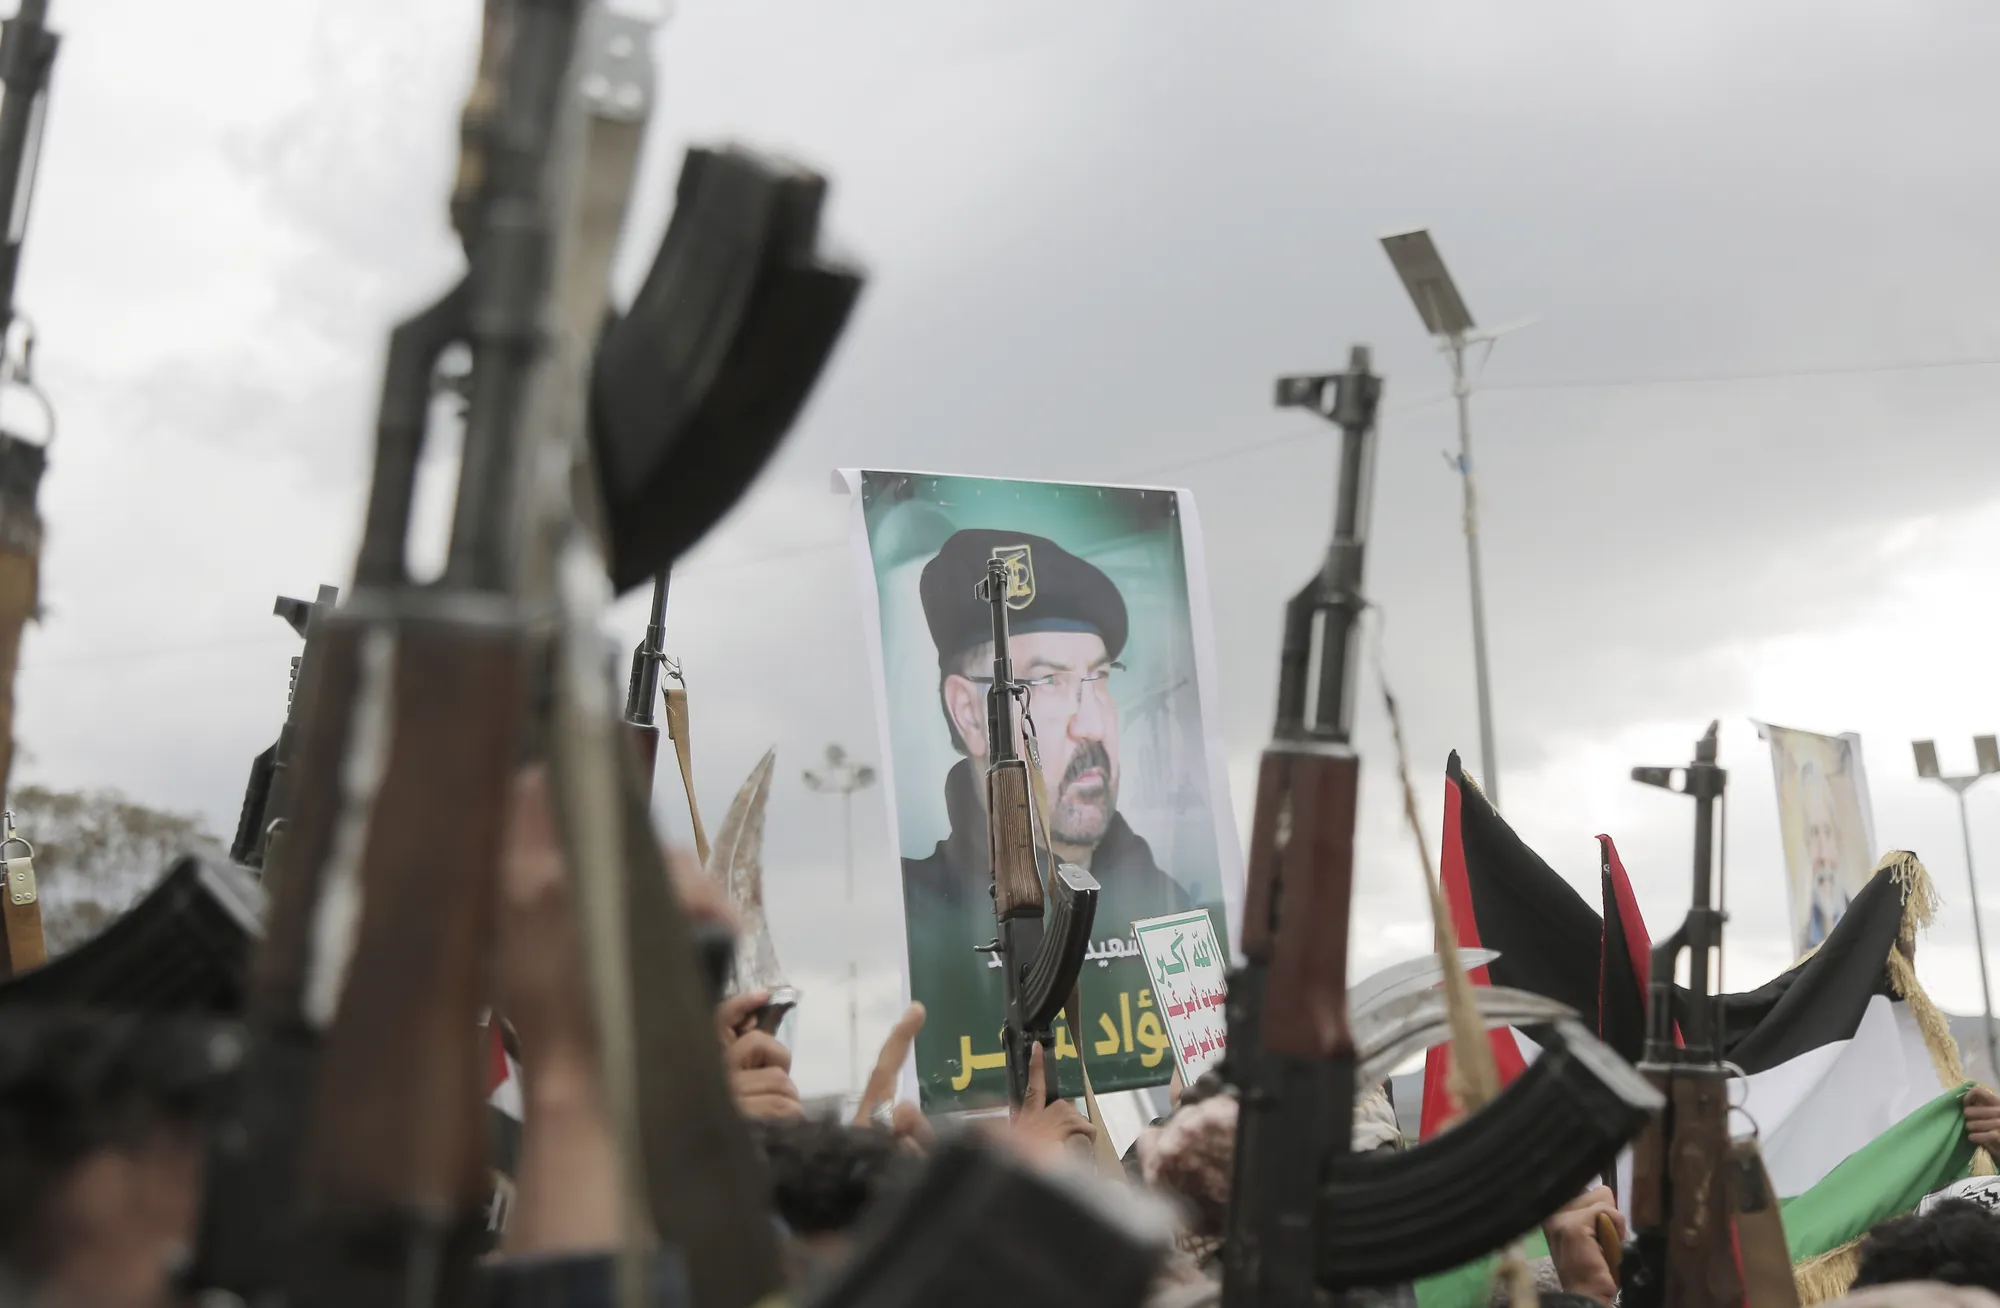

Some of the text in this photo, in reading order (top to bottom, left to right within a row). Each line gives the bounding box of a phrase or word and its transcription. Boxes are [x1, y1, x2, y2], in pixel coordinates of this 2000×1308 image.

[1085, 929, 1141, 968] شهيد
[1192, 931, 1217, 968] الله
[1094, 988, 1170, 1068] ؤاد
